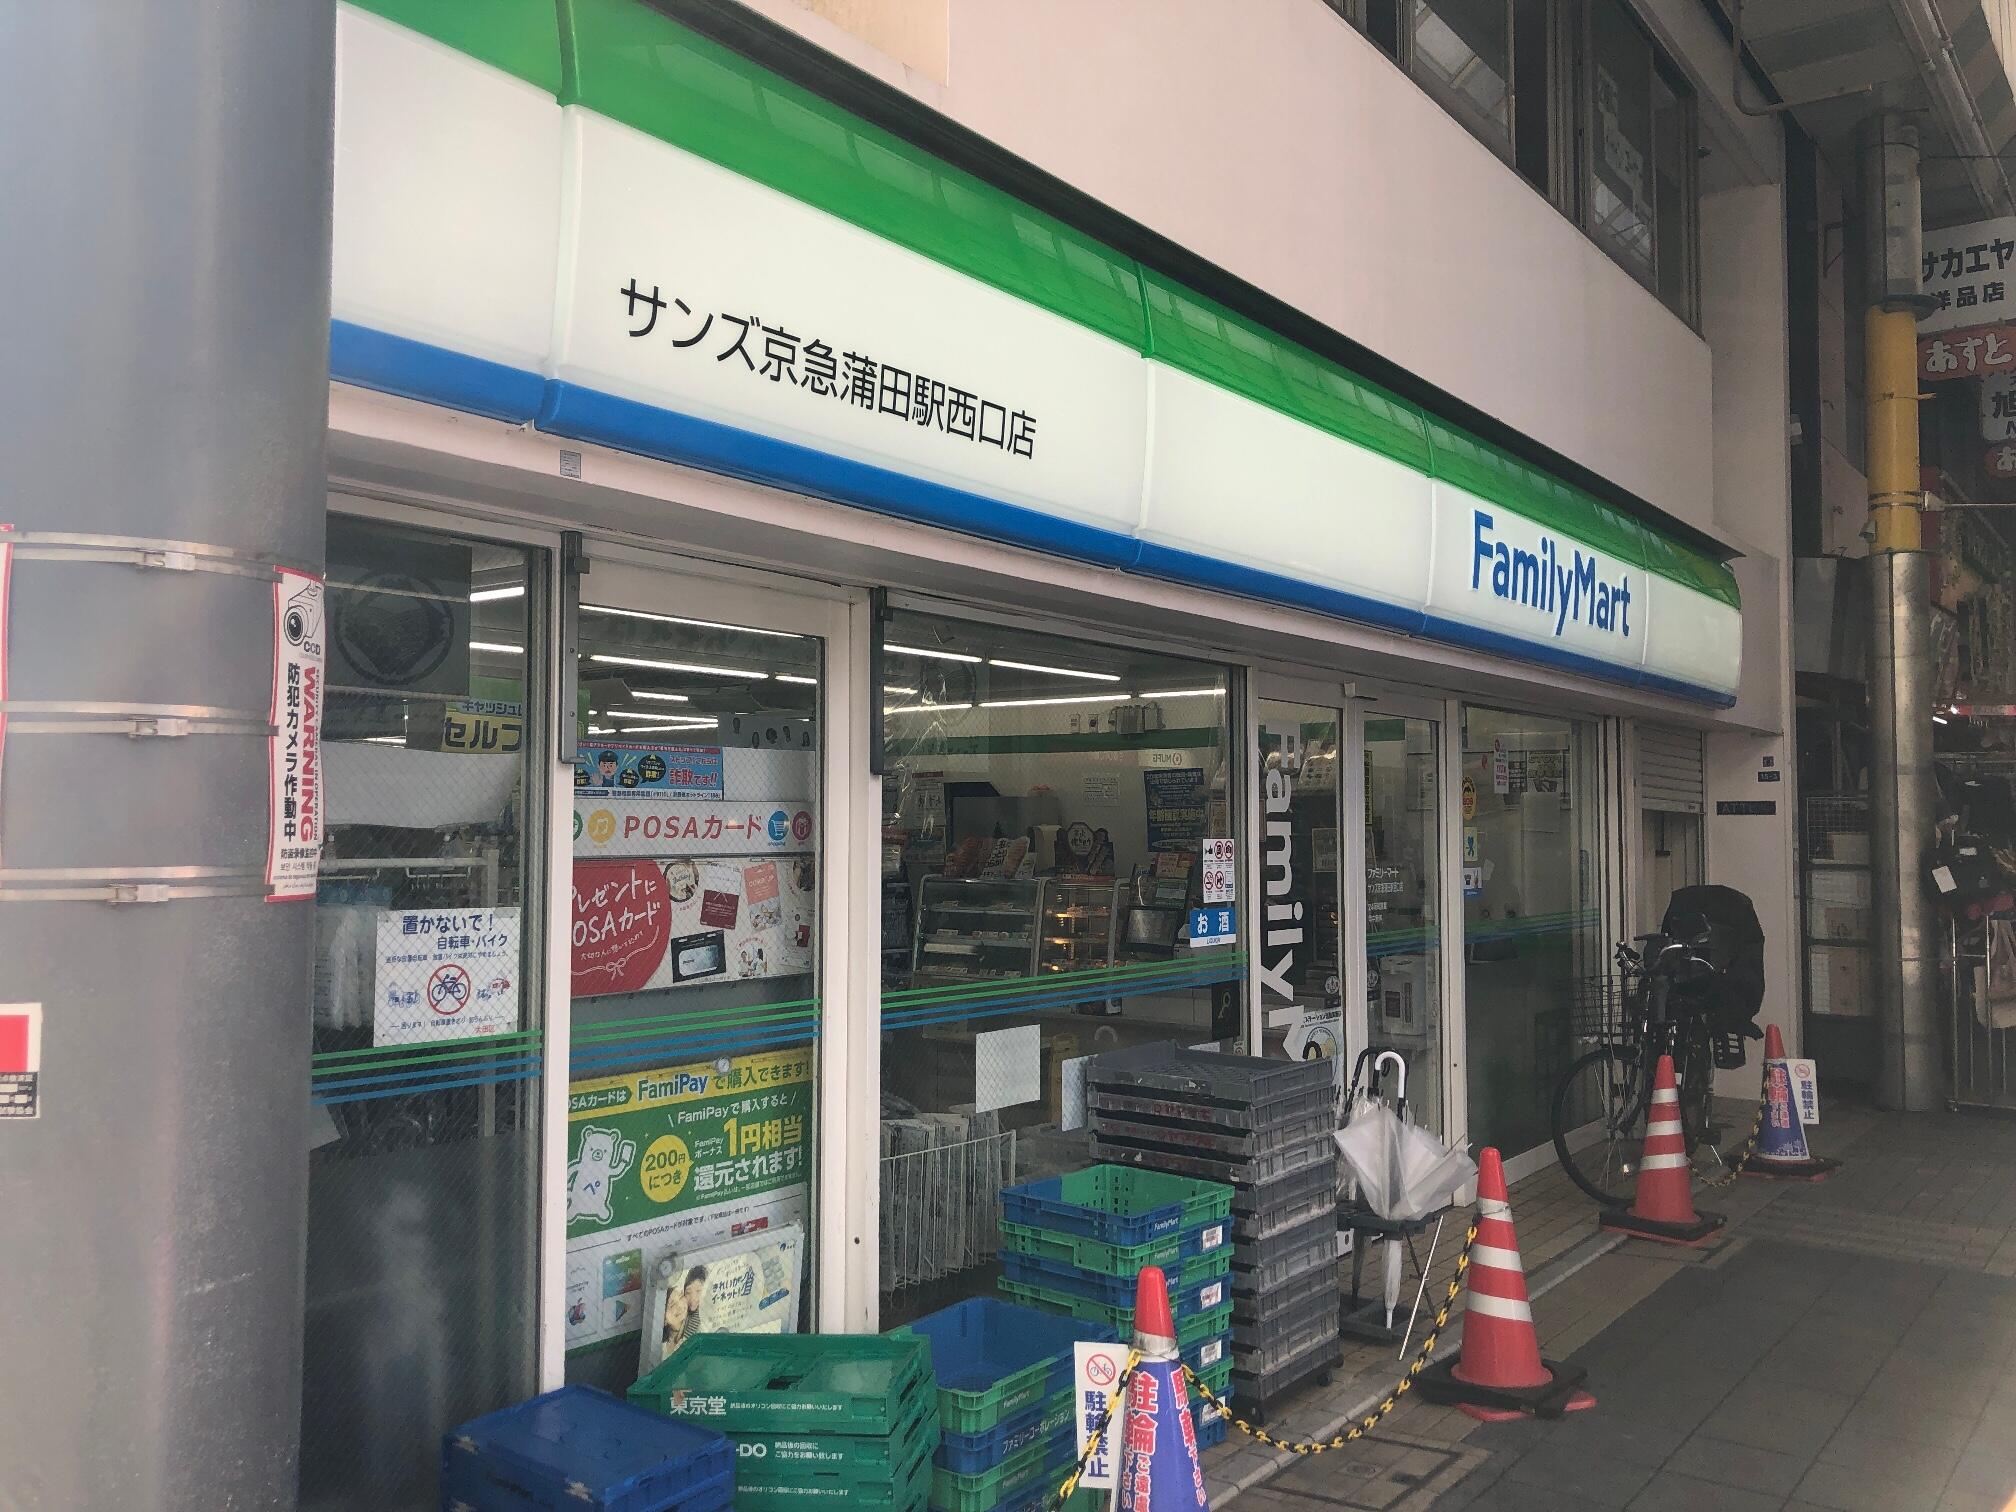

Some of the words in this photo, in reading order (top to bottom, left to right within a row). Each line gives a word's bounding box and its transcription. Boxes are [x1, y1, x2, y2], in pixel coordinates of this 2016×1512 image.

[1922, 238, 2015, 283] サカエヤ
[621, 278, 1037, 460] サンズ京急蒲田駅西口店
[1472, 509, 1631, 637] FamilyMart
[303, 641, 321, 656] CCD
[284, 663, 301, 842] 防犯カメラ作動中
[300, 666, 318, 843] WARNING
[624, 814, 763, 840] POSAカード
[1197, 911, 1230, 934] お酒
[638, 1072, 708, 1102] FamiPay
[1801, 1080, 1815, 1120] 駐輪禁止
[724, 1114, 802, 1158] 1円相当
[645, 1149, 686, 1172] 200円
[649, 1171, 683, 1190] につき
[694, 1147, 802, 1192] 還元されます!
[669, 1396, 727, 1416] 東京堂
